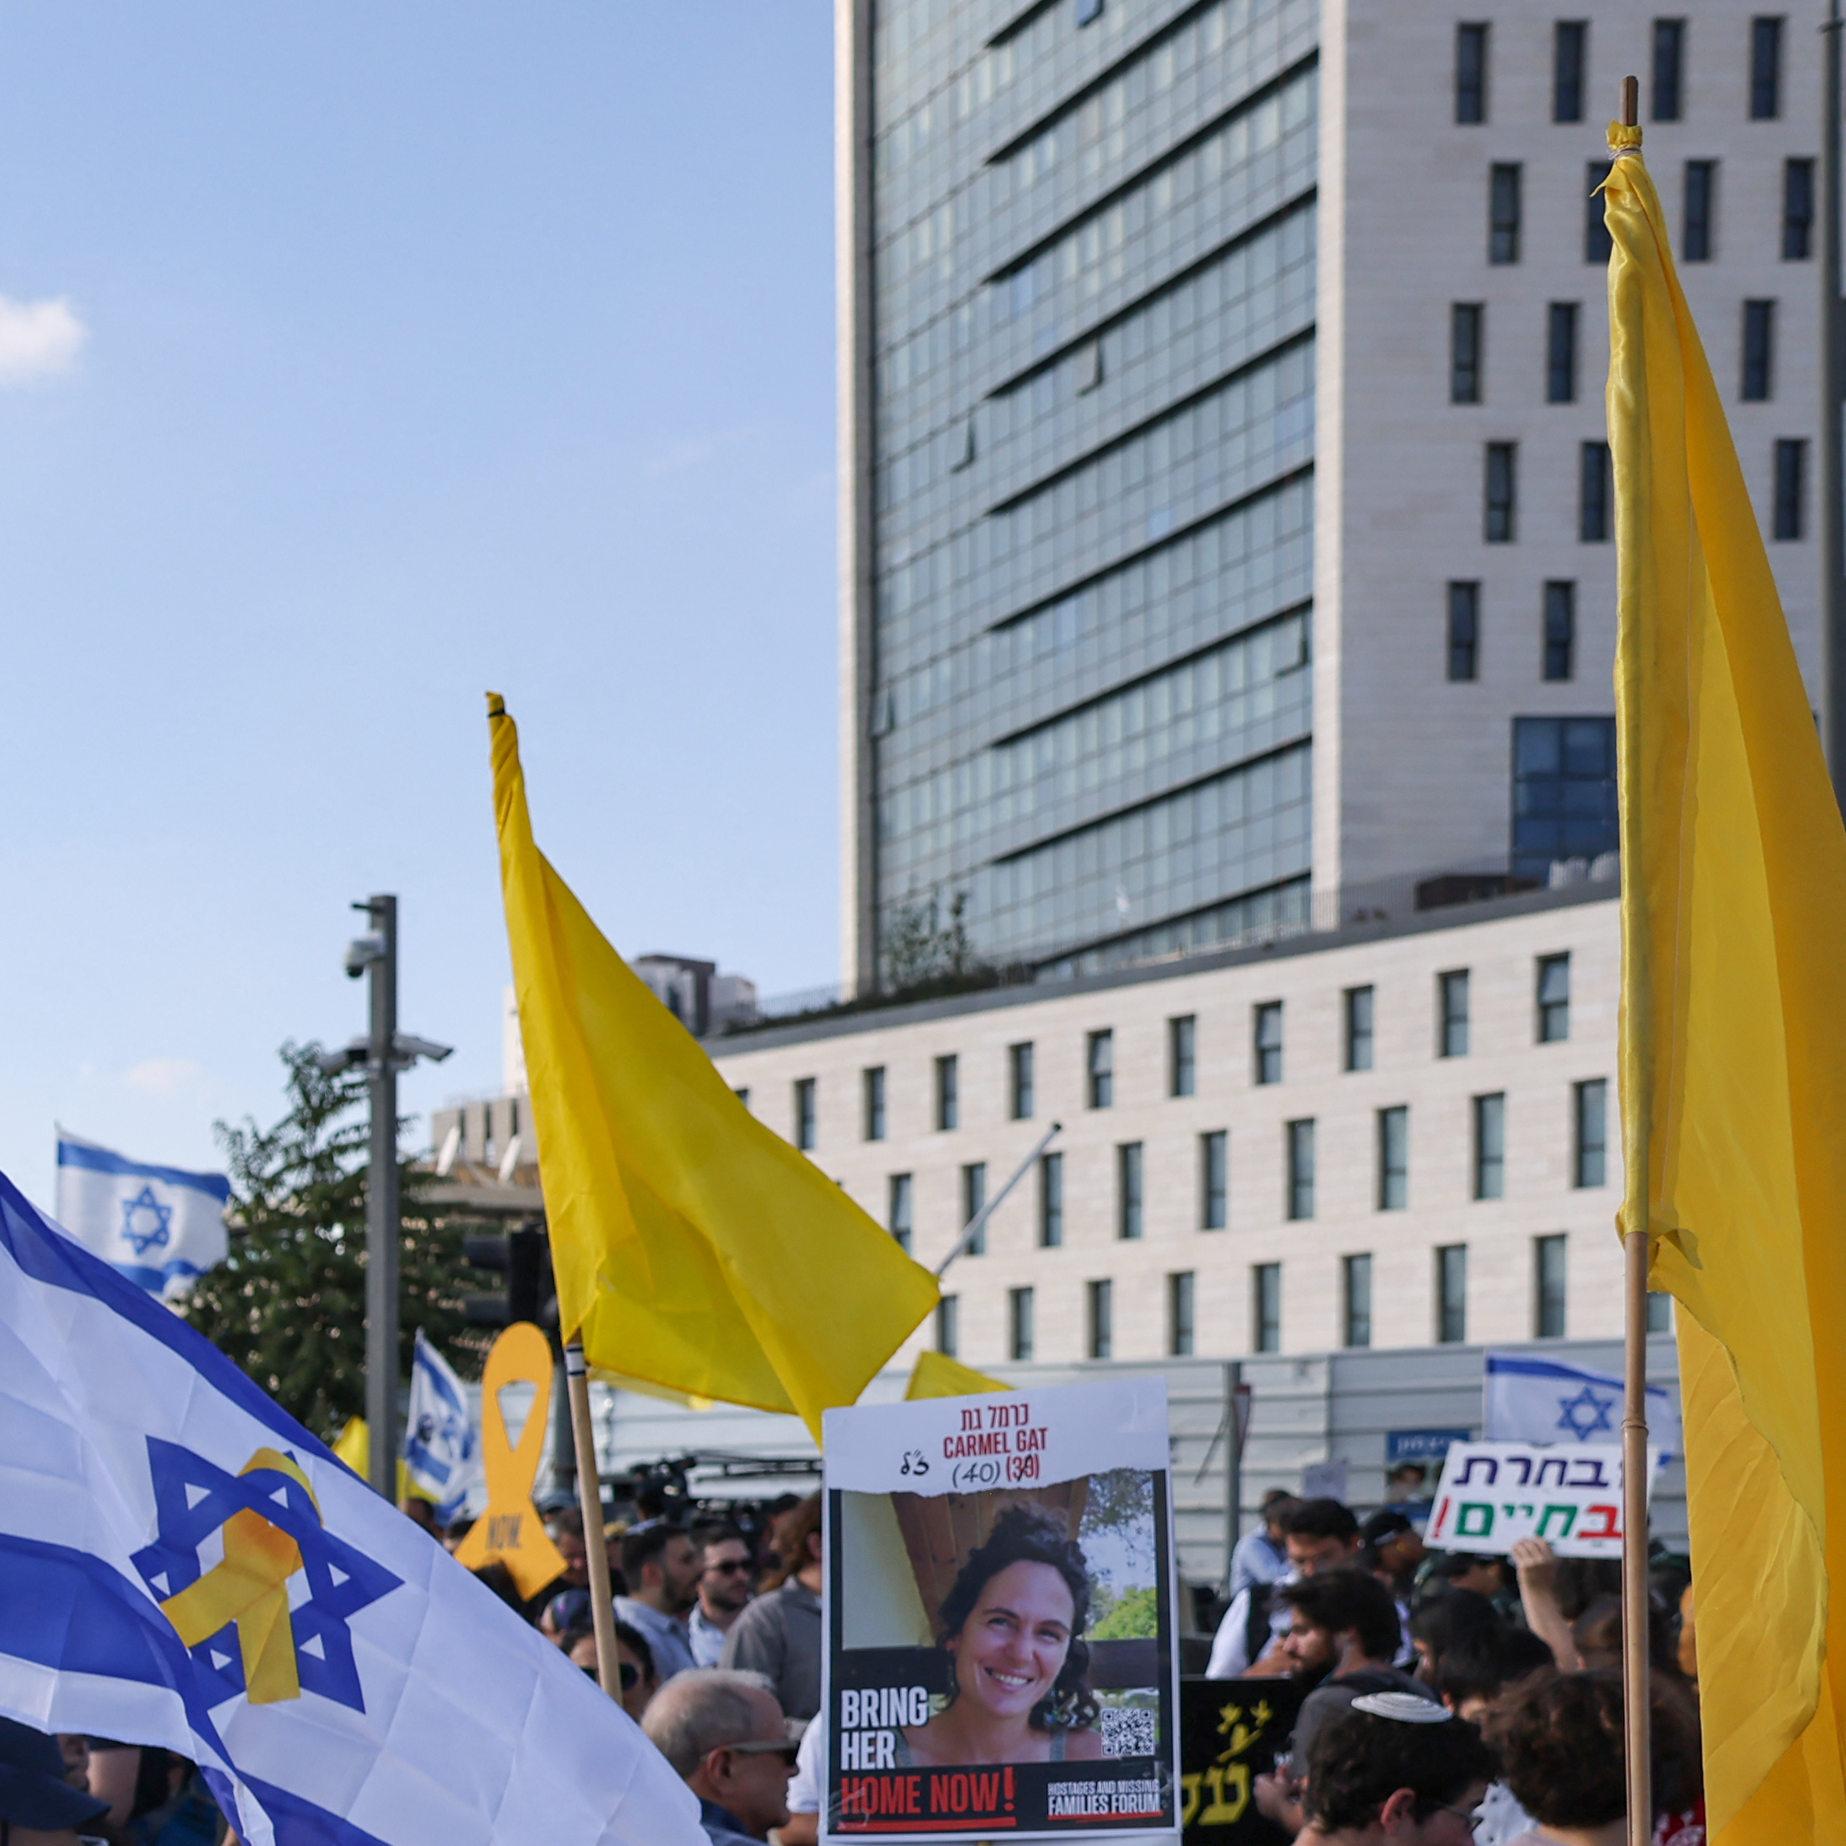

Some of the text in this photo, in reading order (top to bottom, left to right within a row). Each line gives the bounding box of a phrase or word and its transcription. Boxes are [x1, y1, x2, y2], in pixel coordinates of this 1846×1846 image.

[961, 1403, 1029, 1431] כרמל גת
[943, 1427, 1049, 1459] CARMEL GAT
[952, 1460, 1001, 1488] (40)
[1452, 1455, 1623, 1488] בחרת
[1431, 1494, 1624, 1540] בחיים!
[840, 1685, 928, 1729] BRING
[840, 1729, 896, 1771] HER
[840, 1766, 1015, 1815] HOME NOW!
[1048, 1778, 1160, 1795] HOSTAGES AND MISSING
[1048, 1793, 1160, 1815] FAMILIES FORUM
